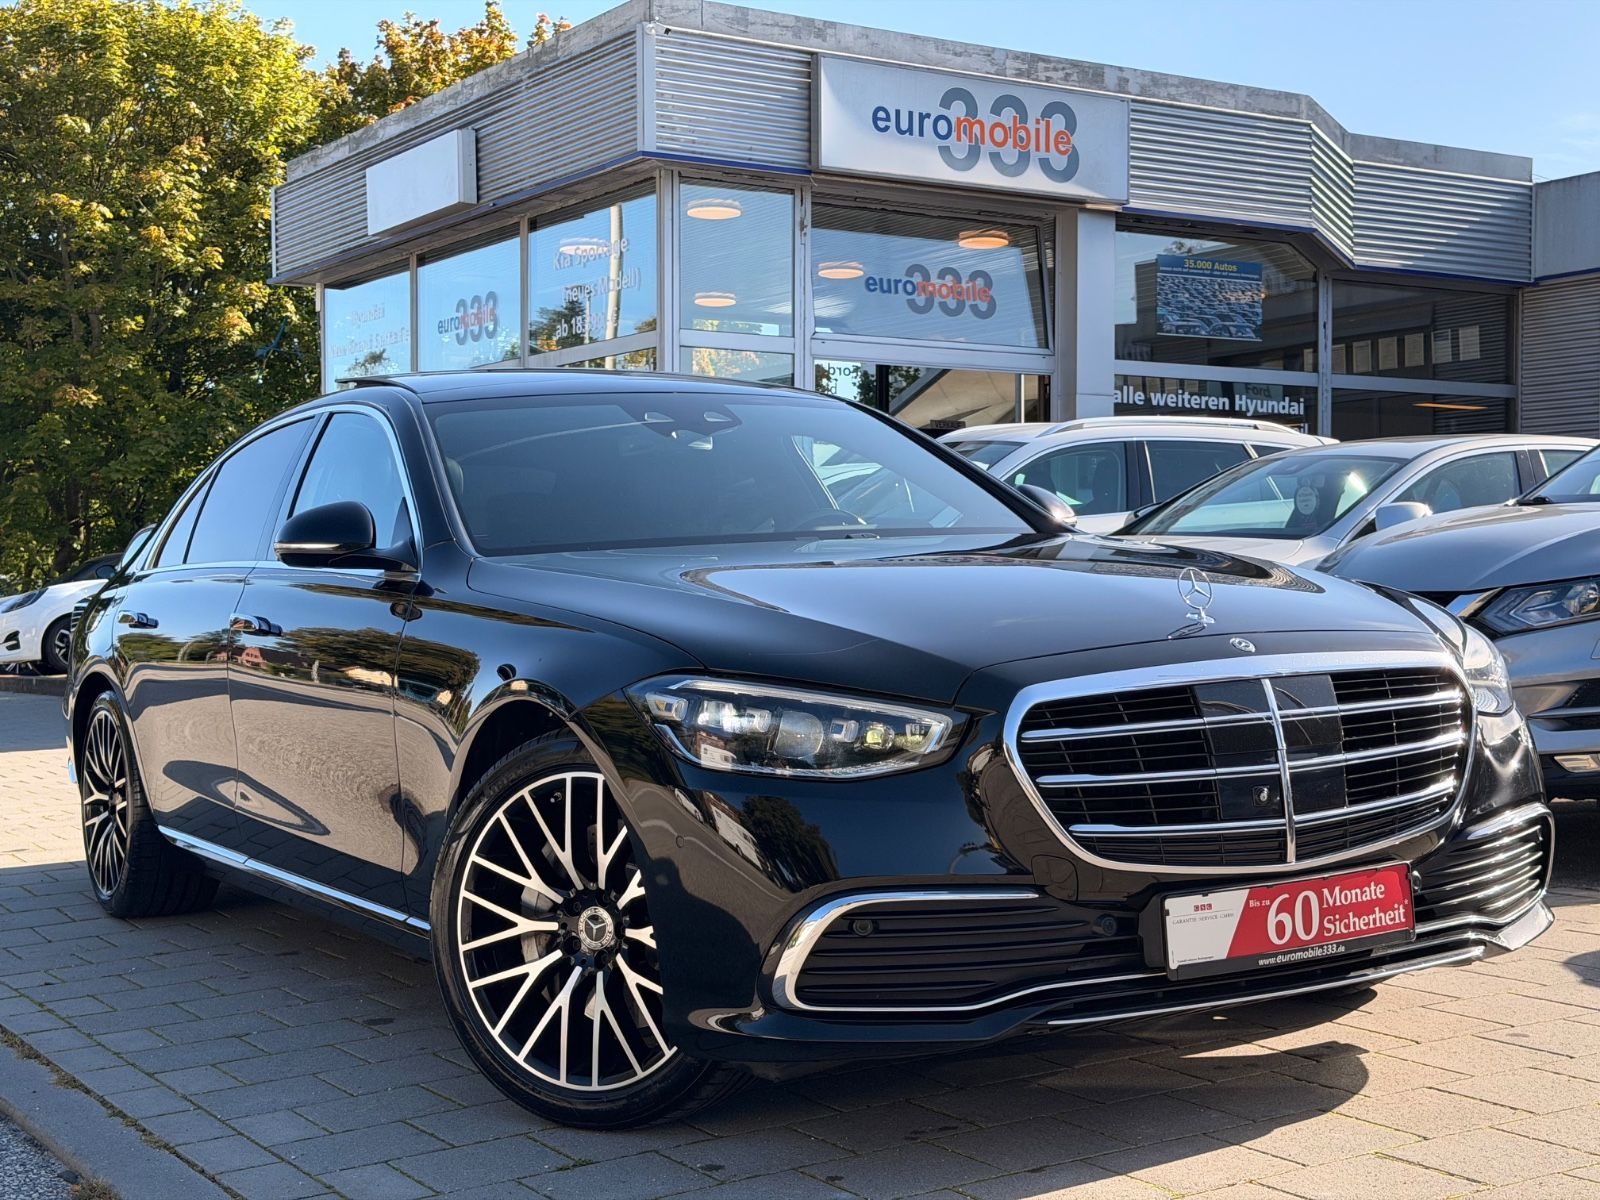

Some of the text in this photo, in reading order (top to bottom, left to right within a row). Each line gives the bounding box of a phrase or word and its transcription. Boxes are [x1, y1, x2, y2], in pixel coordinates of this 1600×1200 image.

[871, 105, 1073, 156] euromobile
[938, 87, 1080, 183] 333
[1184, 259, 1213, 270] 35.000
[1214, 262, 1239, 273] Autos
[864, 275, 991, 303] euromobile
[904, 263, 997, 319] 333
[455, 290, 498, 346] 333
[555, 318, 569, 339] ab
[1113, 386, 1305, 416] alle weiteren Hyundai
[1249, 881, 1385, 945] Bis zu 60 Monate
[1258, 944, 1346, 967] www.euromobile333.de
